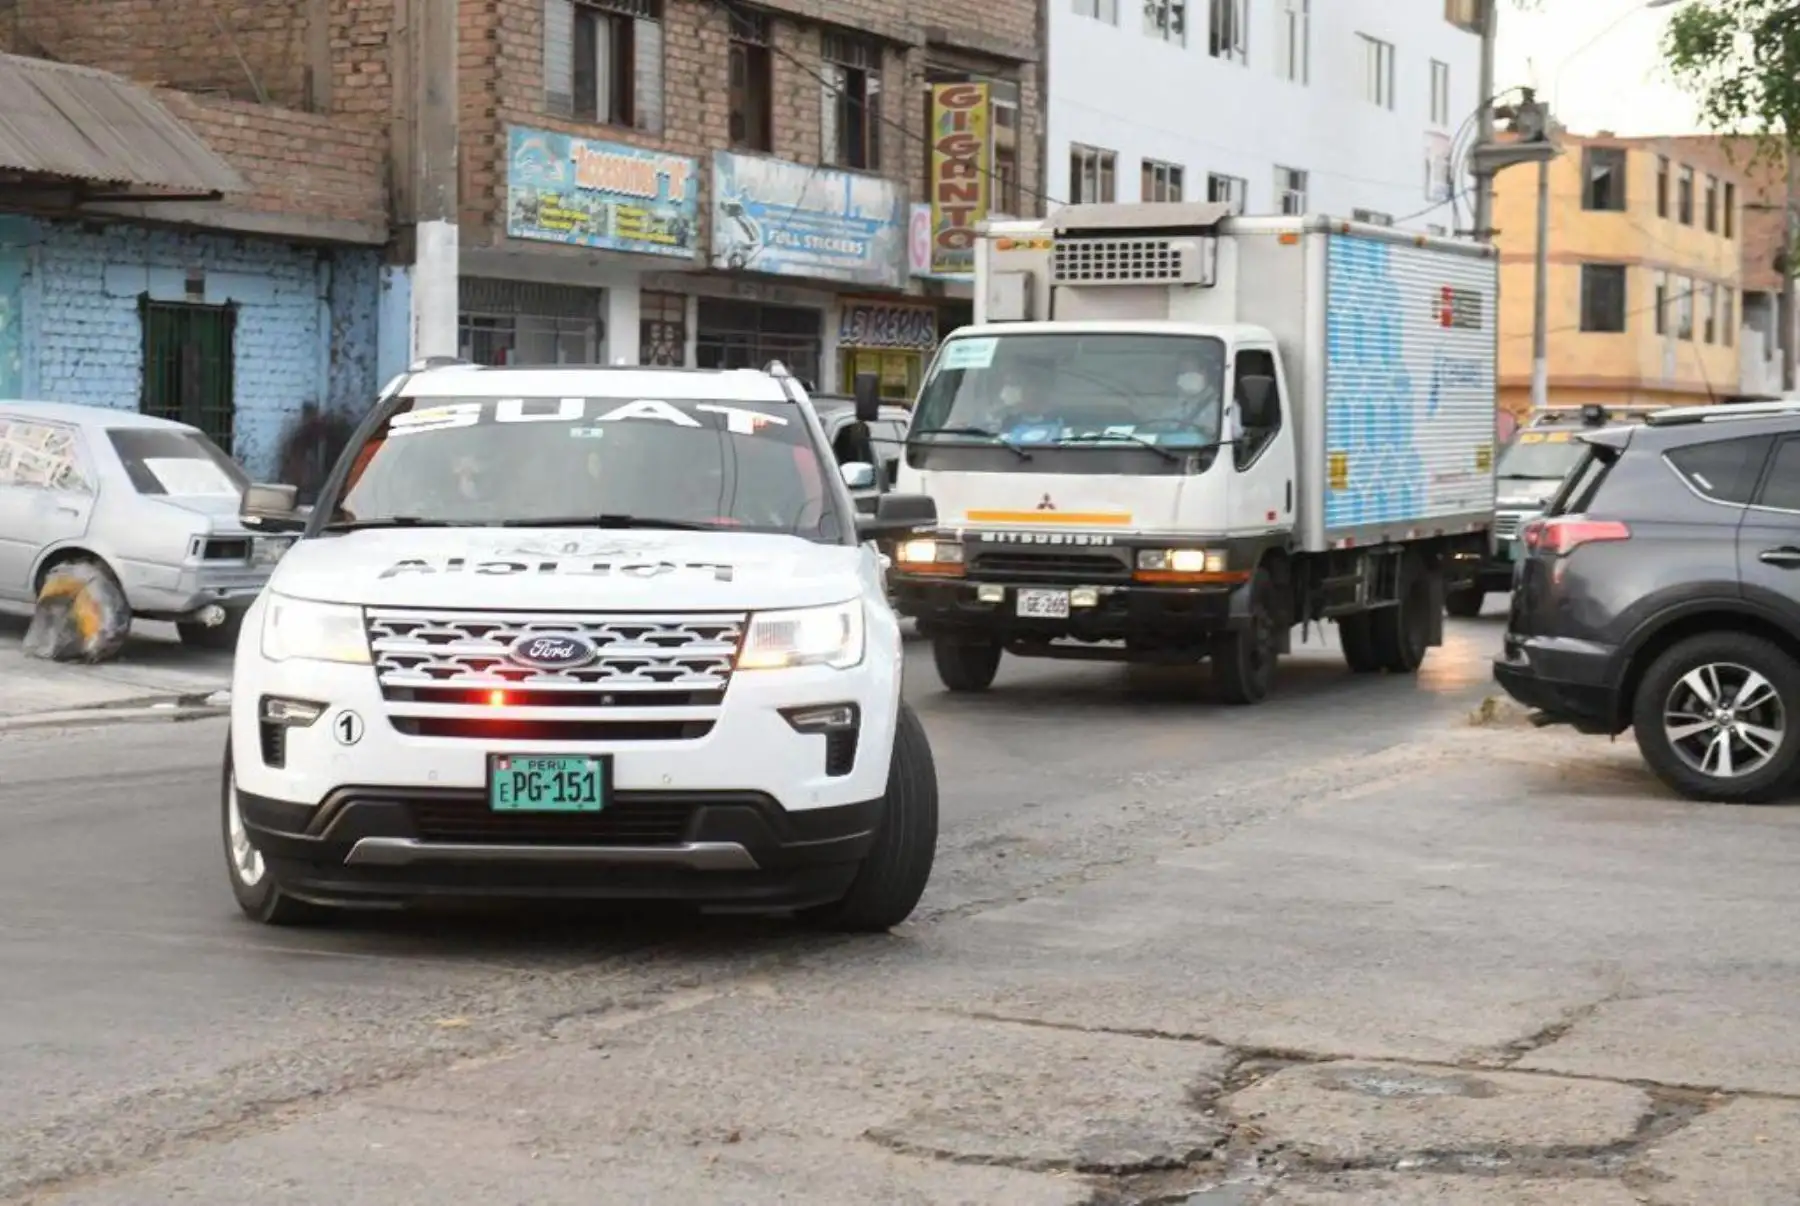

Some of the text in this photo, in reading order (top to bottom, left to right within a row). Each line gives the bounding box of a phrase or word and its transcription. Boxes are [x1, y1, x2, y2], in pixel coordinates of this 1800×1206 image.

[933, 86, 984, 250] GIGANTO
[767, 229, 865, 255] FULL STICKERS
[839, 304, 936, 348] LETREROS
[387, 397, 789, 438] SUAT
[981, 531, 1113, 546] MITSUBISHI
[529, 640, 576, 659] Ford
[528, 760, 567, 771] PERU
